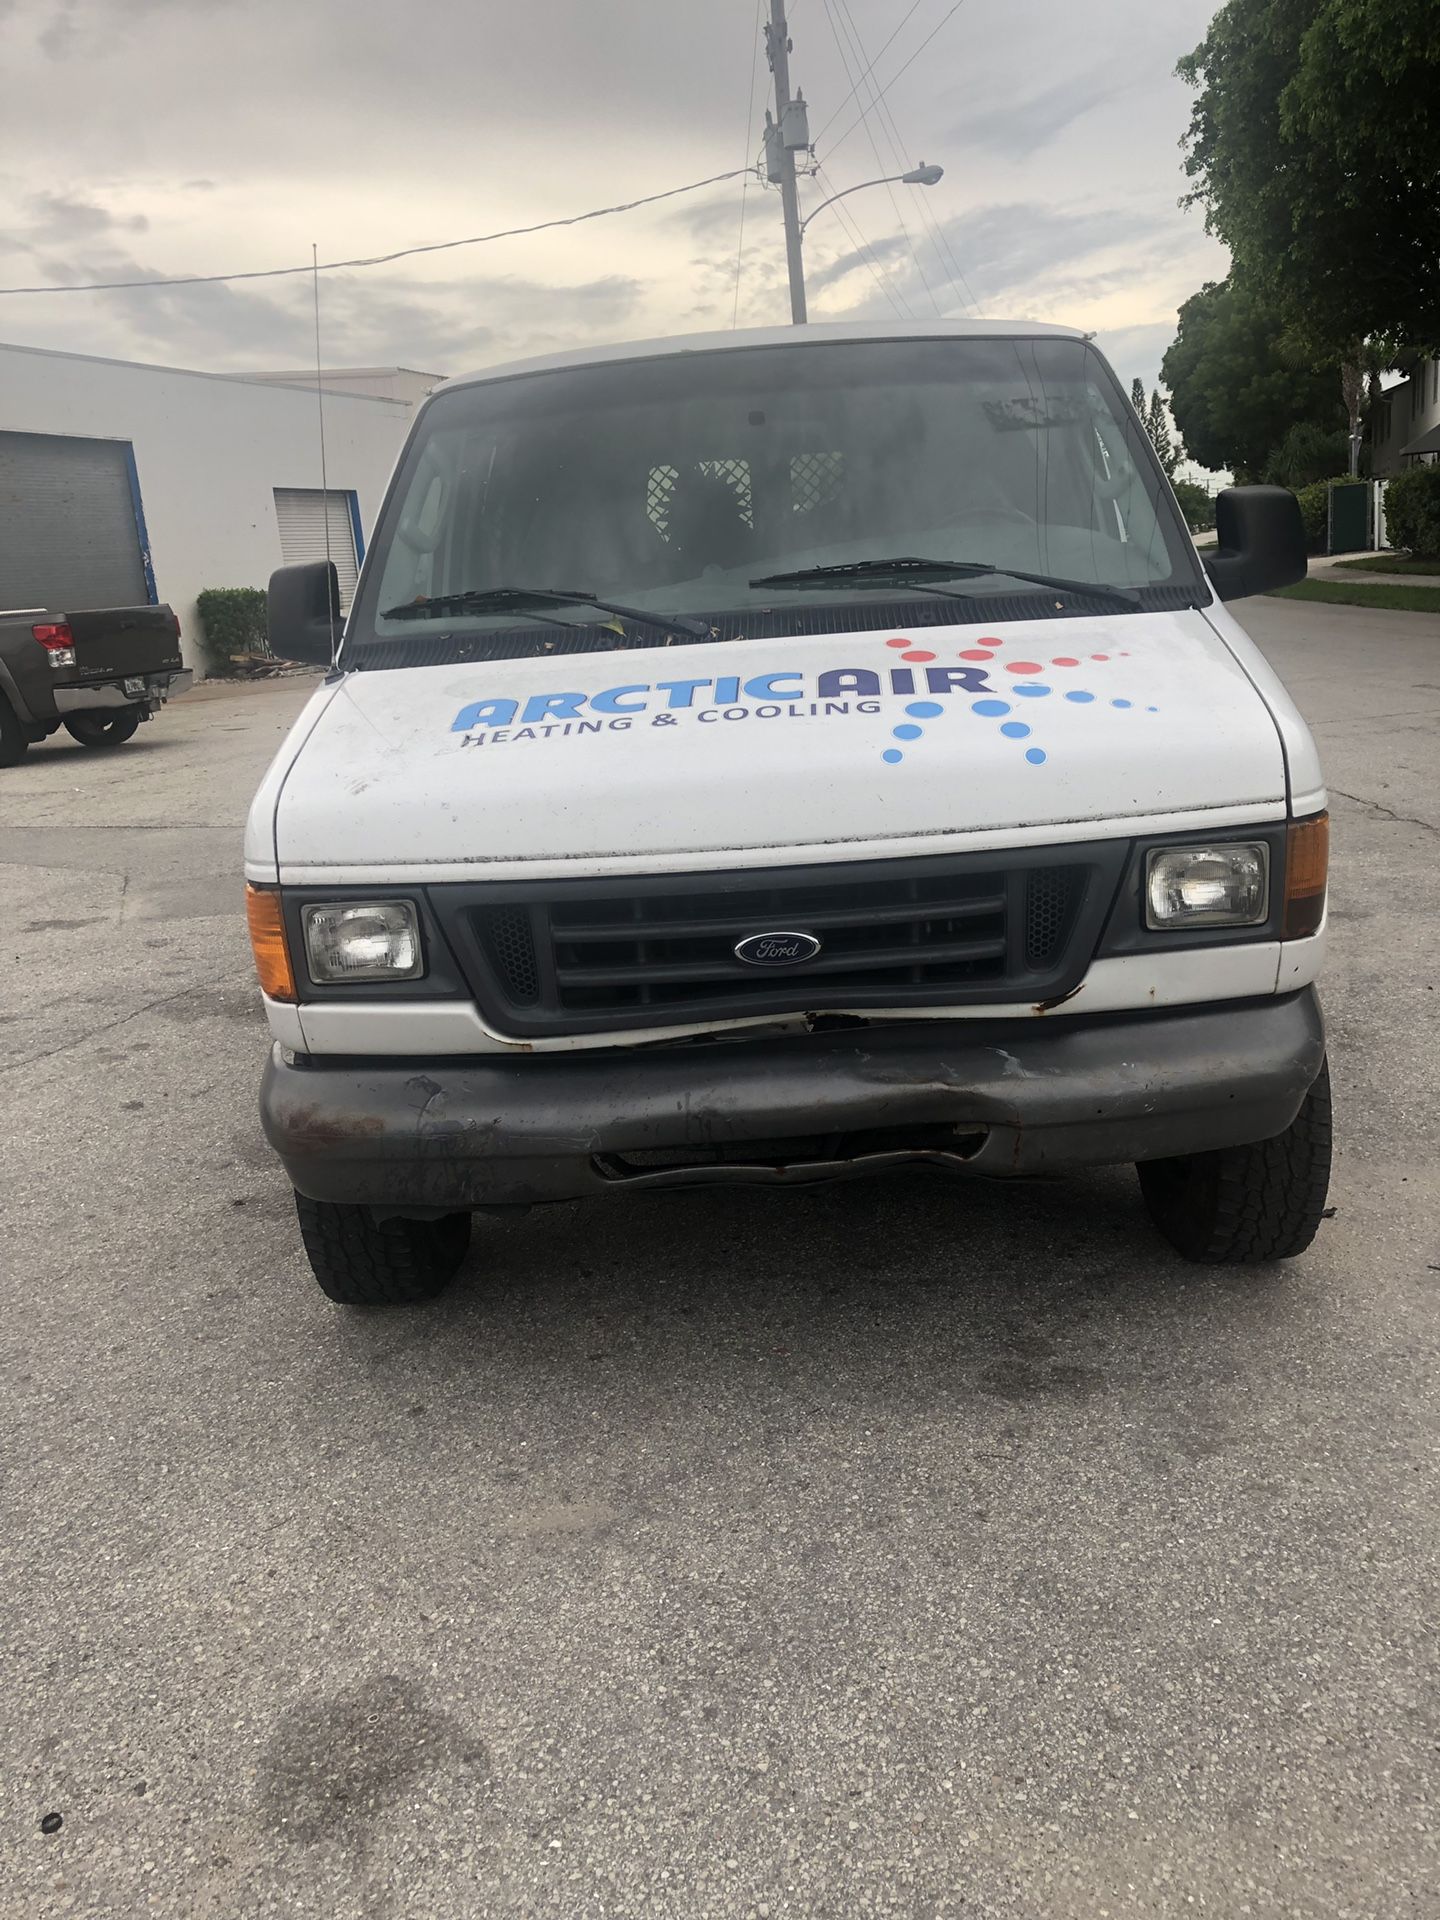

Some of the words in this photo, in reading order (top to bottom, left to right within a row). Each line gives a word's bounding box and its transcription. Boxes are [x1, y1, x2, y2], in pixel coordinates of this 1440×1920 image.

[460, 717, 633, 747] HEATING
[651, 713, 678, 727] &
[697, 701, 881, 723] COOLING
[756, 939, 800, 958] Ford
